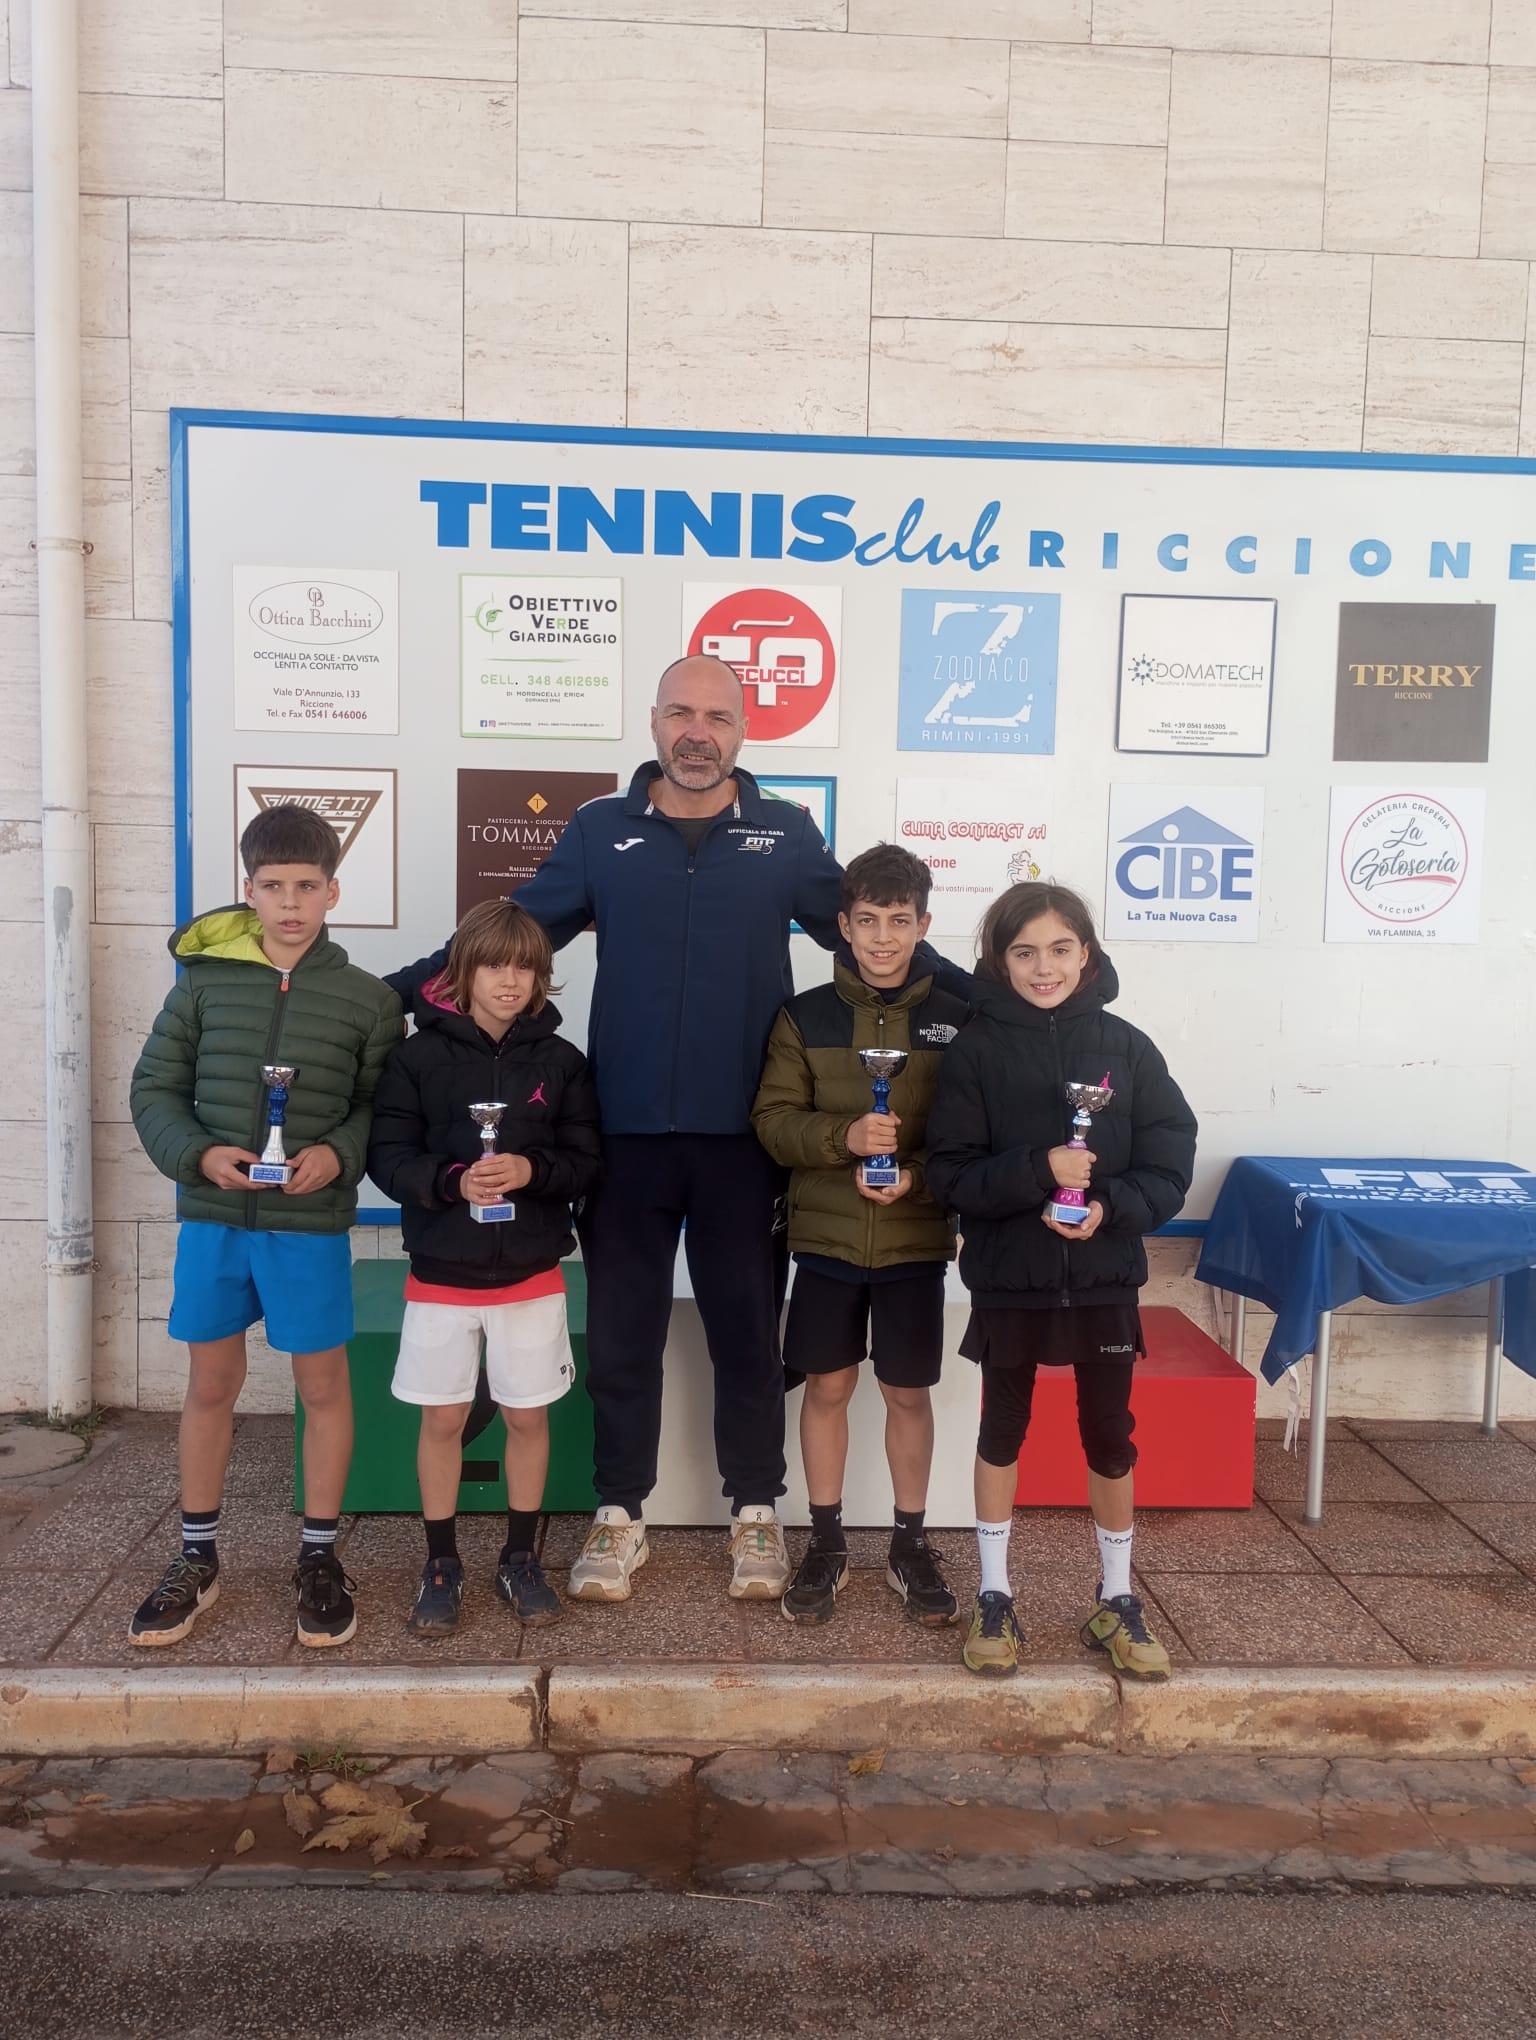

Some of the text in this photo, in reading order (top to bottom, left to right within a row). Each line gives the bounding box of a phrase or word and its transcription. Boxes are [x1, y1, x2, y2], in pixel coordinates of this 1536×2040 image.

[420, 480, 1536, 580] TENNIS club RICCIONE
[509, 594, 618, 613] OBIETTIVO
[259, 606, 372, 628] Ottica Bacchini
[531, 613, 589, 630] VERDE
[509, 630, 617, 644] GIARDINAGGIO
[253, 651, 297, 660] OCCHIALI
[298, 652, 312, 661] DA
[313, 653, 335, 662] SOLE
[342, 654, 356, 662] DA
[357, 654, 380, 663] VISTA
[274, 661, 359, 671] LENTI A CONTATTO
[933, 655, 1029, 682] ZODIACO
[1156, 662, 1264, 681] DOMATECH
[480, 673, 609, 688] CELL. 348 4612696
[735, 669, 805, 683] SCUCCI
[1348, 664, 1483, 688] TERRY
[273, 687, 360, 699] Viale D'Annunzio, 133
[1394, 692, 1433, 700] RICCIONE
[300, 699, 335, 709] Riccione
[266, 709, 280, 718] Tel.
[289, 710, 303, 719] Fax
[305, 709, 328, 719] 0541
[332, 710, 368, 720] 646006
[921, 729, 1031, 744] RIMINI 1991
[1362, 802, 1408, 829] GELATERIA
[902, 821, 1047, 842] CLIMA CONTRACT srl
[1383, 817, 1428, 849] La
[1115, 845, 1254, 900] CIBE
[945, 884, 965, 893] vostri
[965, 885, 994, 895] impianti
[1377, 903, 1427, 914] RICCIONE
[1127, 911, 1237, 922] La Tua Nuova Casa
[1367, 928, 1382, 938] VIA
[1383, 929, 1425, 938] FLAMINIA,
[919, 1029, 949, 1037] NORTH
[927, 1035, 949, 1043] FACE
